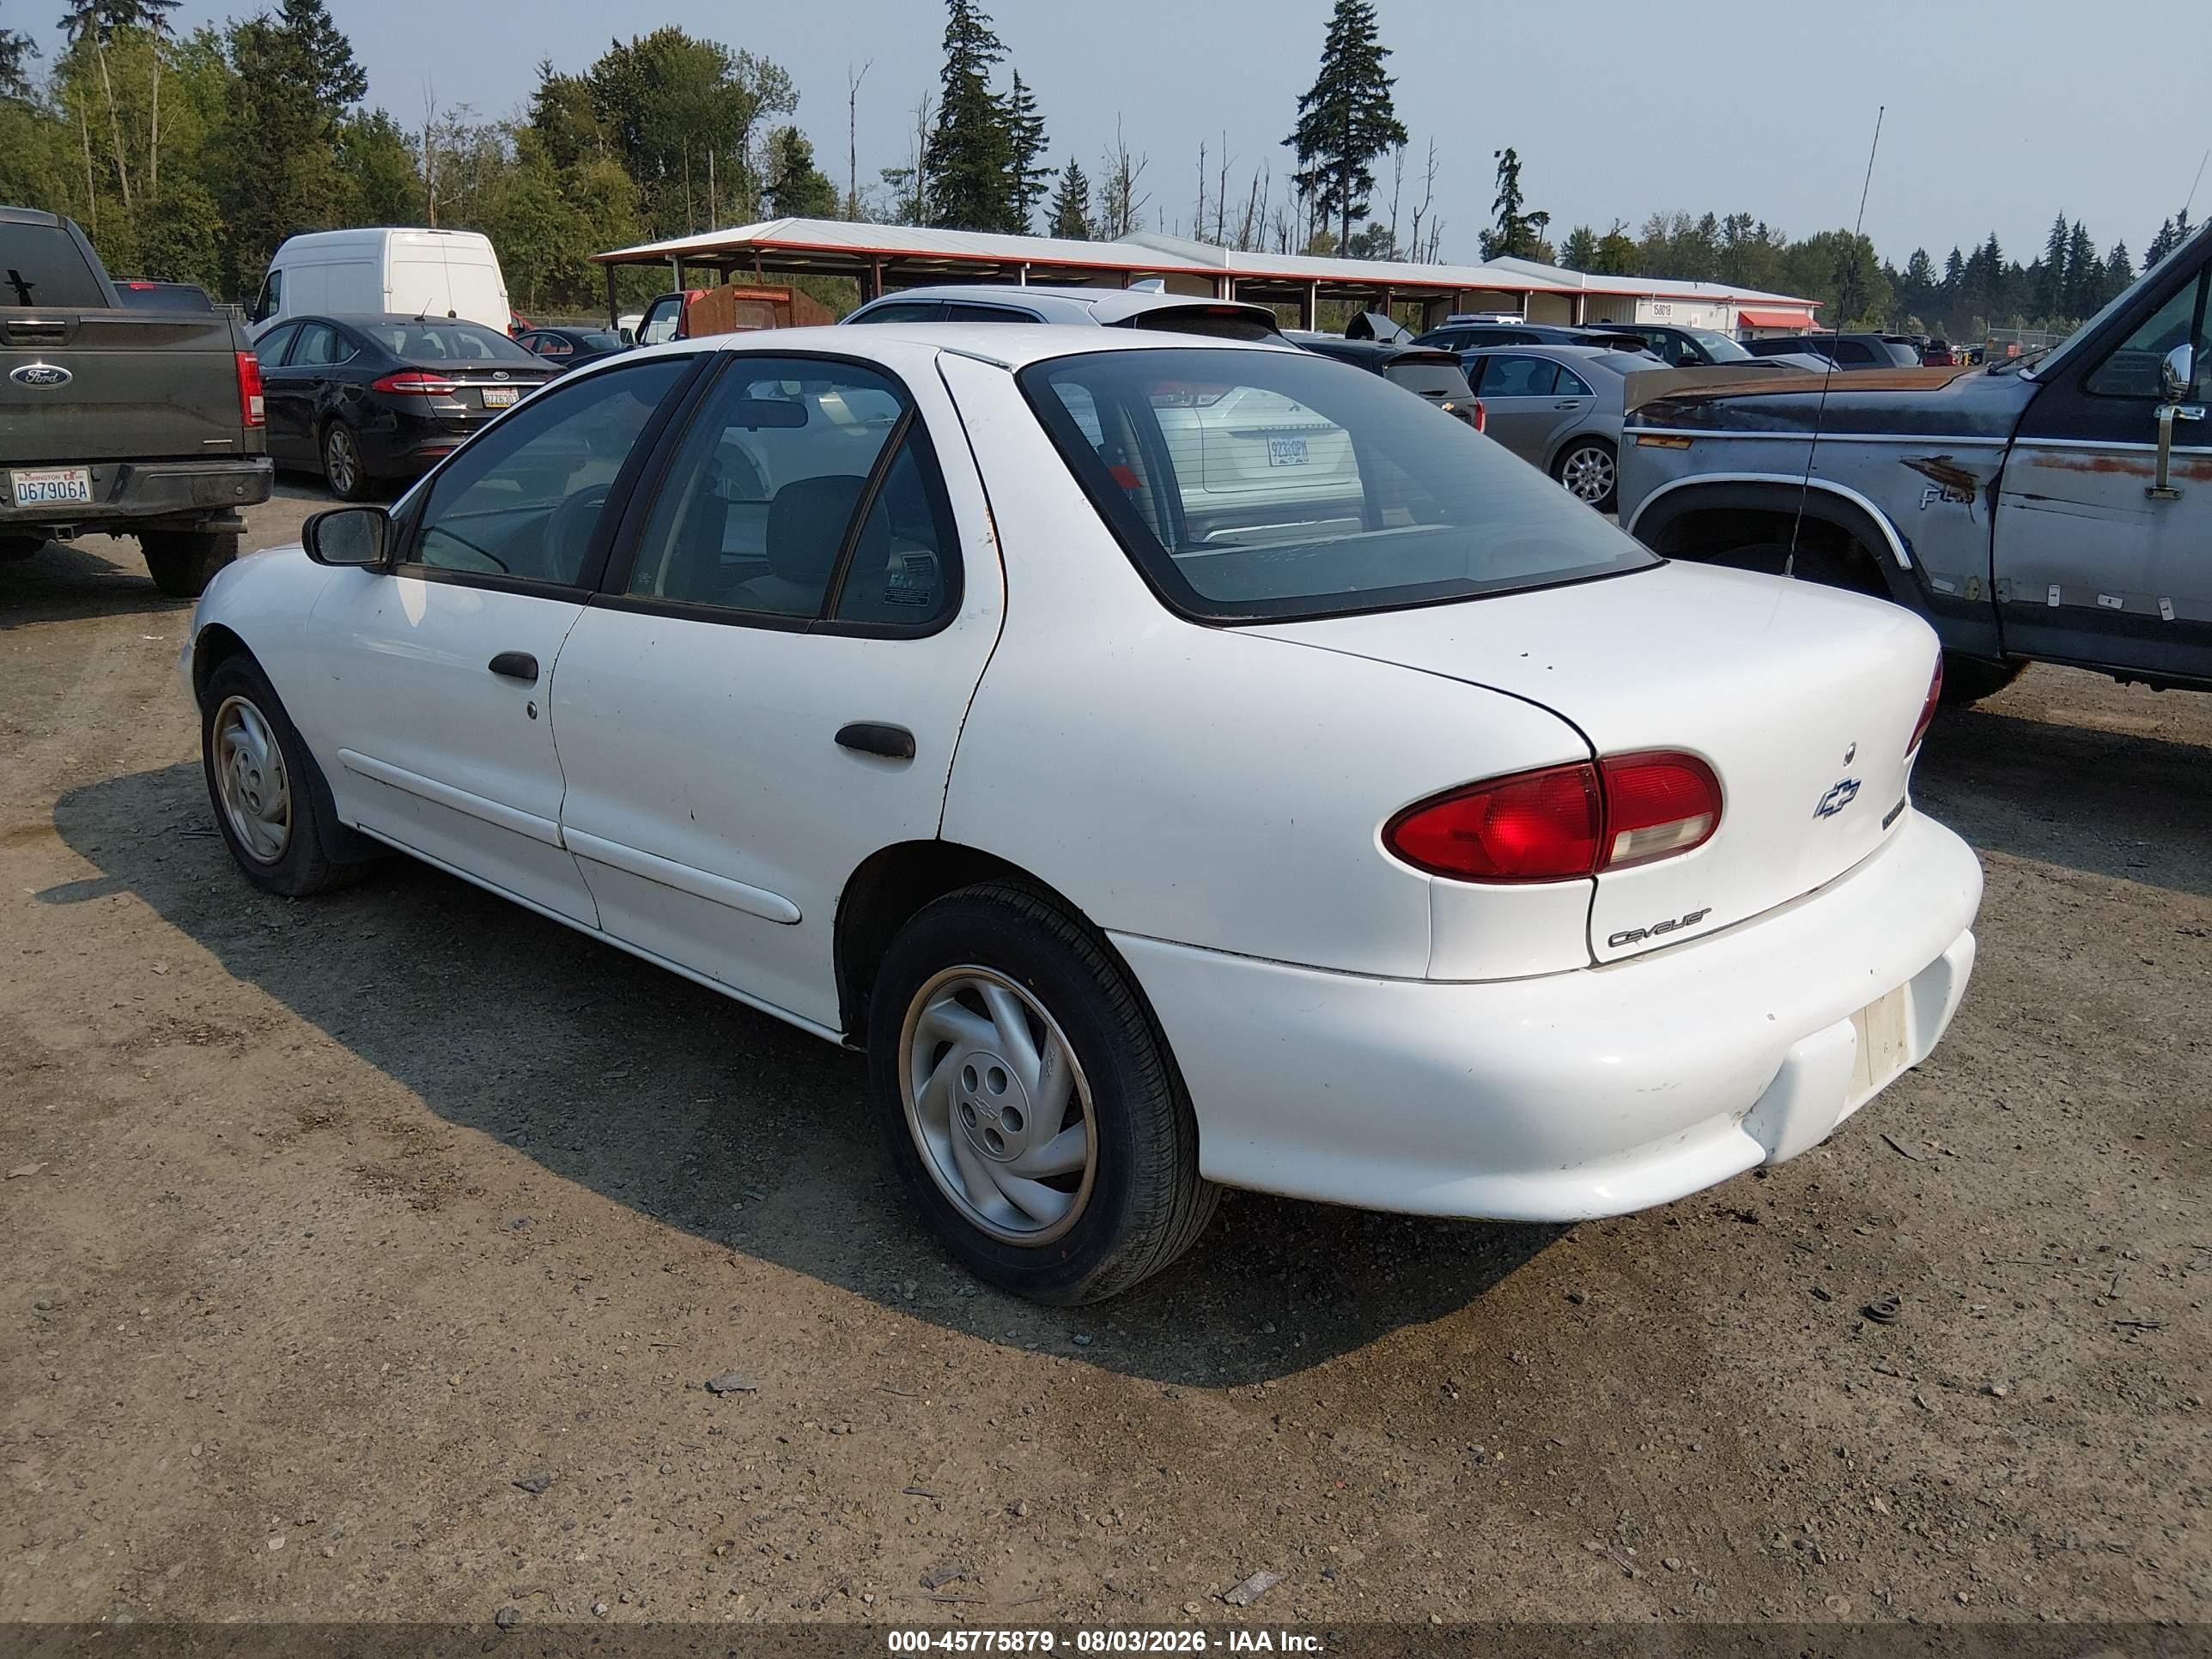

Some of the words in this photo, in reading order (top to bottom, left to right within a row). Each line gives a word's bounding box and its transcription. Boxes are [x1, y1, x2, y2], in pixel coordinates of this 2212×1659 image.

[17, 473, 61, 482] WASHINGTON
[17, 481, 88, 501] D67906A
[1607, 907, 1712, 948] Cavalier
